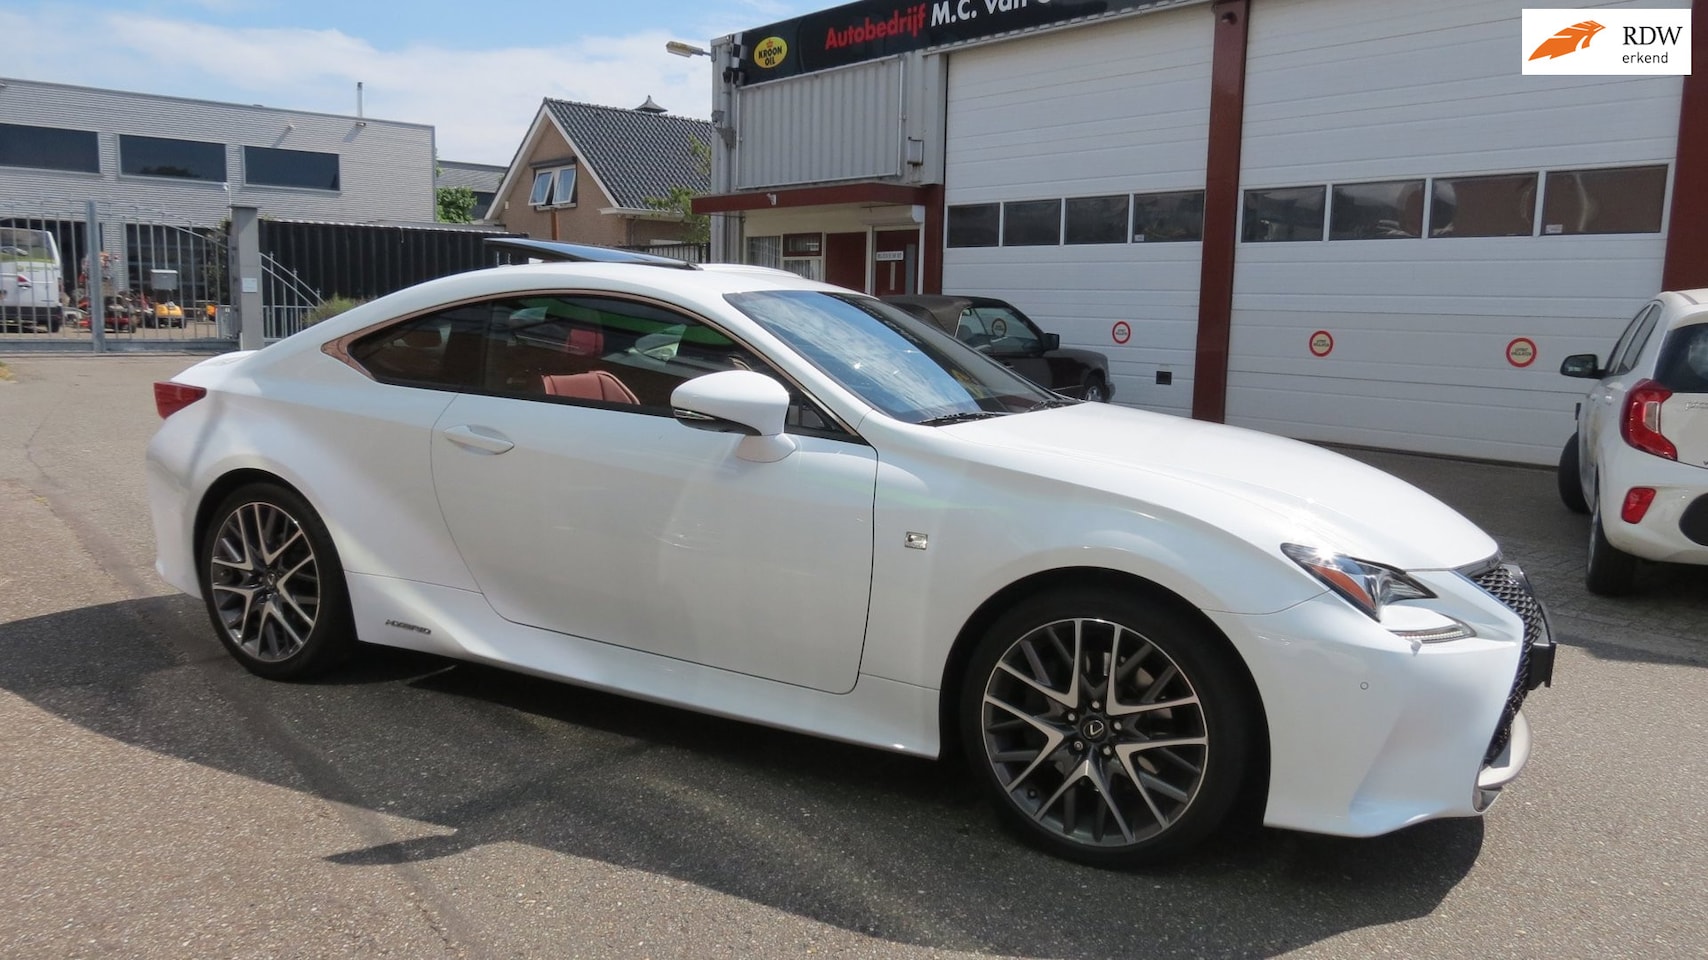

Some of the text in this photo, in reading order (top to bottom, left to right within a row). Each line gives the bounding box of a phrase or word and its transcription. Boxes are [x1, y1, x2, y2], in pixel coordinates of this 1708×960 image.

[825, 3, 926, 50] Autobedrijf
[931, 0, 977, 27] M.C.
[758, 46, 783, 59] KROON
[765, 56, 775, 66] OIL
